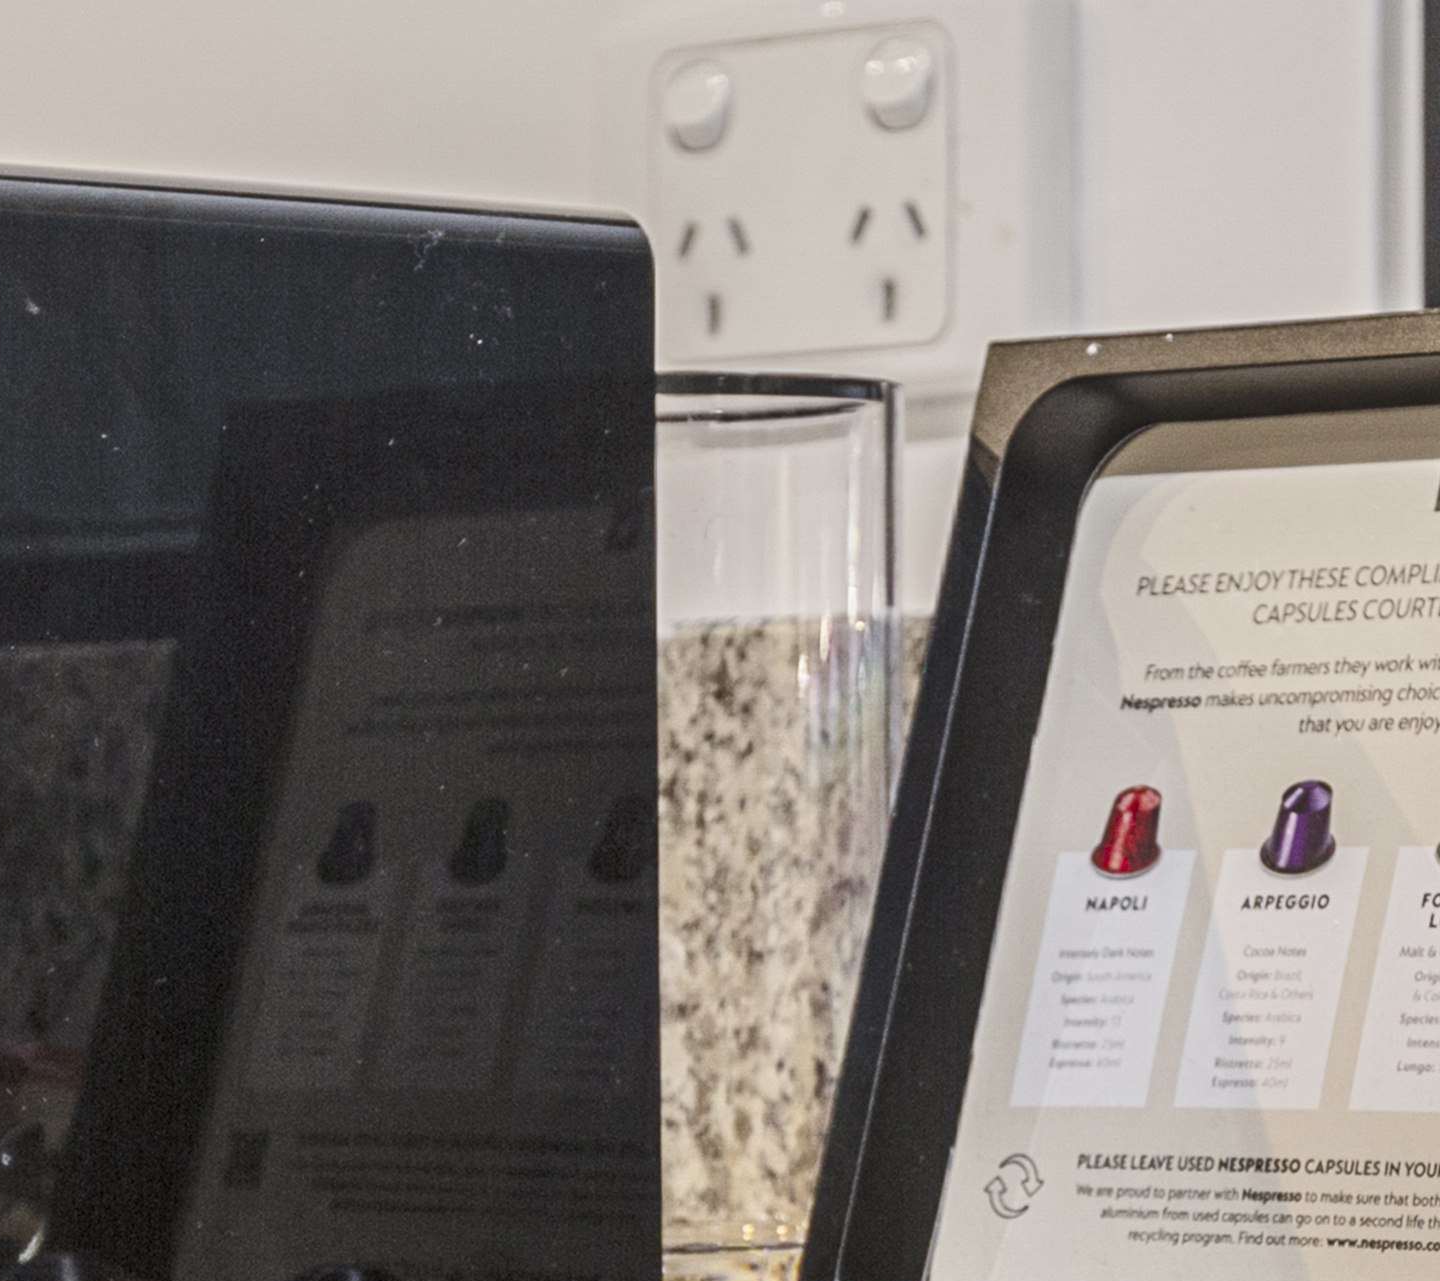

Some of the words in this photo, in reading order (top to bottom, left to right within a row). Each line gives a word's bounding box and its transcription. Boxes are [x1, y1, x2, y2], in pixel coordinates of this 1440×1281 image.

[1136, 573, 1211, 596] PLEASE
[1216, 569, 1285, 593] ENJOY
[1287, 567, 1351, 589] THESE
[1253, 600, 1357, 624] CAPSULES
[1145, 664, 1184, 681] From
[1188, 663, 1213, 678] the
[1217, 660, 1267, 677] coffee
[1270, 659, 1330, 677] farmers
[1335, 657, 1370, 677] they
[1374, 655, 1413, 672] work
[1120, 694, 1201, 713] Nespresso
[1205, 691, 1254, 707] makes
[1259, 686, 1392, 708] uncompromising
[1299, 717, 1331, 733] that
[1335, 718, 1364, 736] you
[1368, 718, 1393, 732] are
[1085, 895, 1148, 911] NAPOLI
[1240, 894, 1330, 910] ARPEGGIO
[1077, 1154, 1127, 1170] PLEASE
[1130, 1154, 1174, 1170] LEAVE
[1177, 1156, 1215, 1171] USED
[1218, 1157, 1301, 1174] NESPRESSO
[1305, 1159, 1380, 1176] CAPSULES
[1384, 1161, 1401, 1176] IN
[1076, 1184, 1093, 1197] We
[1096, 1187, 1114, 1197] are
[1116, 1186, 1151, 1200] proud
[1153, 1187, 1165, 1199] to
[1168, 1188, 1211, 1201] partner
[1214, 1187, 1239, 1201] with
[1241, 1188, 1302, 1205] Nespresso
[1305, 1192, 1318, 1204] to
[1320, 1190, 1353, 1205] make
[1355, 1193, 1381, 1206] sure
[1383, 1192, 1409, 1206] that
[1100, 1206, 1159, 1219] aluminium
[1162, 1207, 1190, 1220] from
[1192, 1208, 1220, 1222] used
[1221, 1209, 1269, 1225] capsules
[1272, 1213, 1293, 1224] can
[1295, 1214, 1312, 1228] go
[1314, 1215, 1331, 1225] on
[1333, 1213, 1346, 1226] to
[1359, 1215, 1403, 1228] second
[1405, 1215, 1425, 1229] life
[1128, 1228, 1180, 1246] recycling
[1182, 1231, 1235, 1247] program.
[1238, 1230, 1263, 1246] Find
[1265, 1234, 1286, 1247] out
[1288, 1235, 1323, 1248] more:
